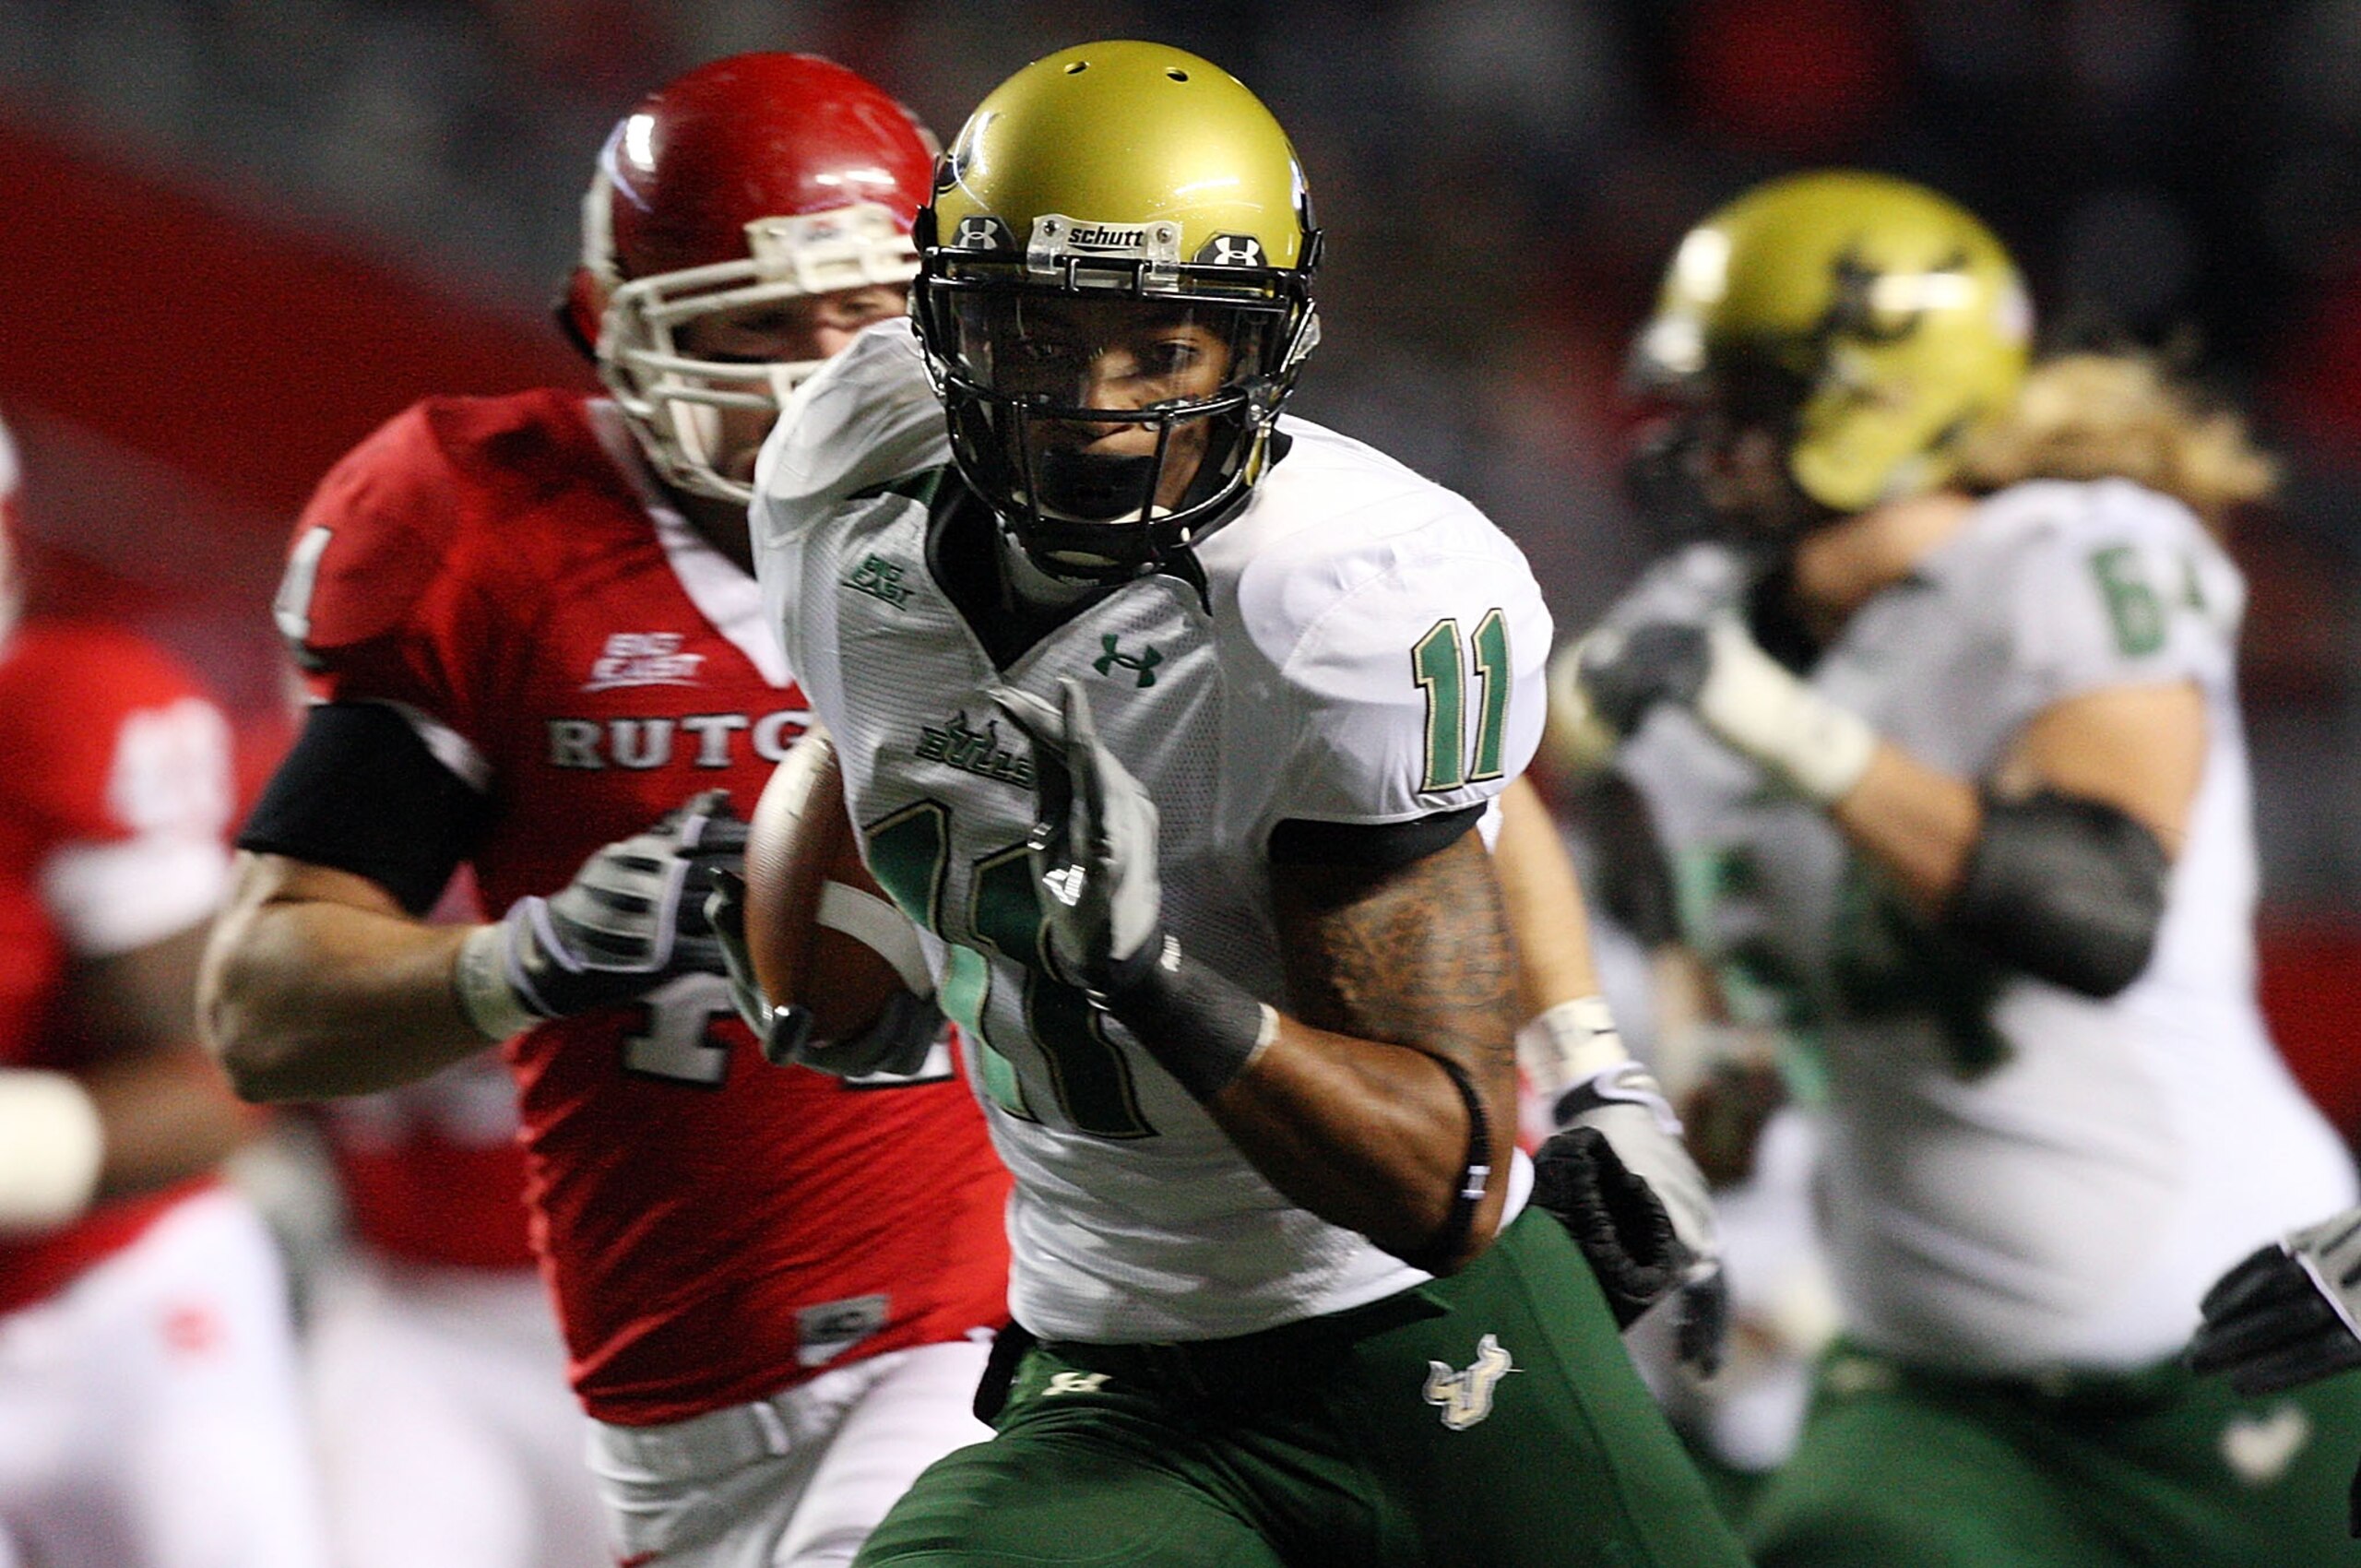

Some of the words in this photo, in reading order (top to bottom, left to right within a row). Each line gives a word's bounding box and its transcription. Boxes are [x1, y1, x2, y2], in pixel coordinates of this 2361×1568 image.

[1067, 226, 1145, 247] schutt
[850, 564, 916, 605] EAST
[1410, 607, 1513, 794] 11
[862, 797, 1162, 1141] 11
